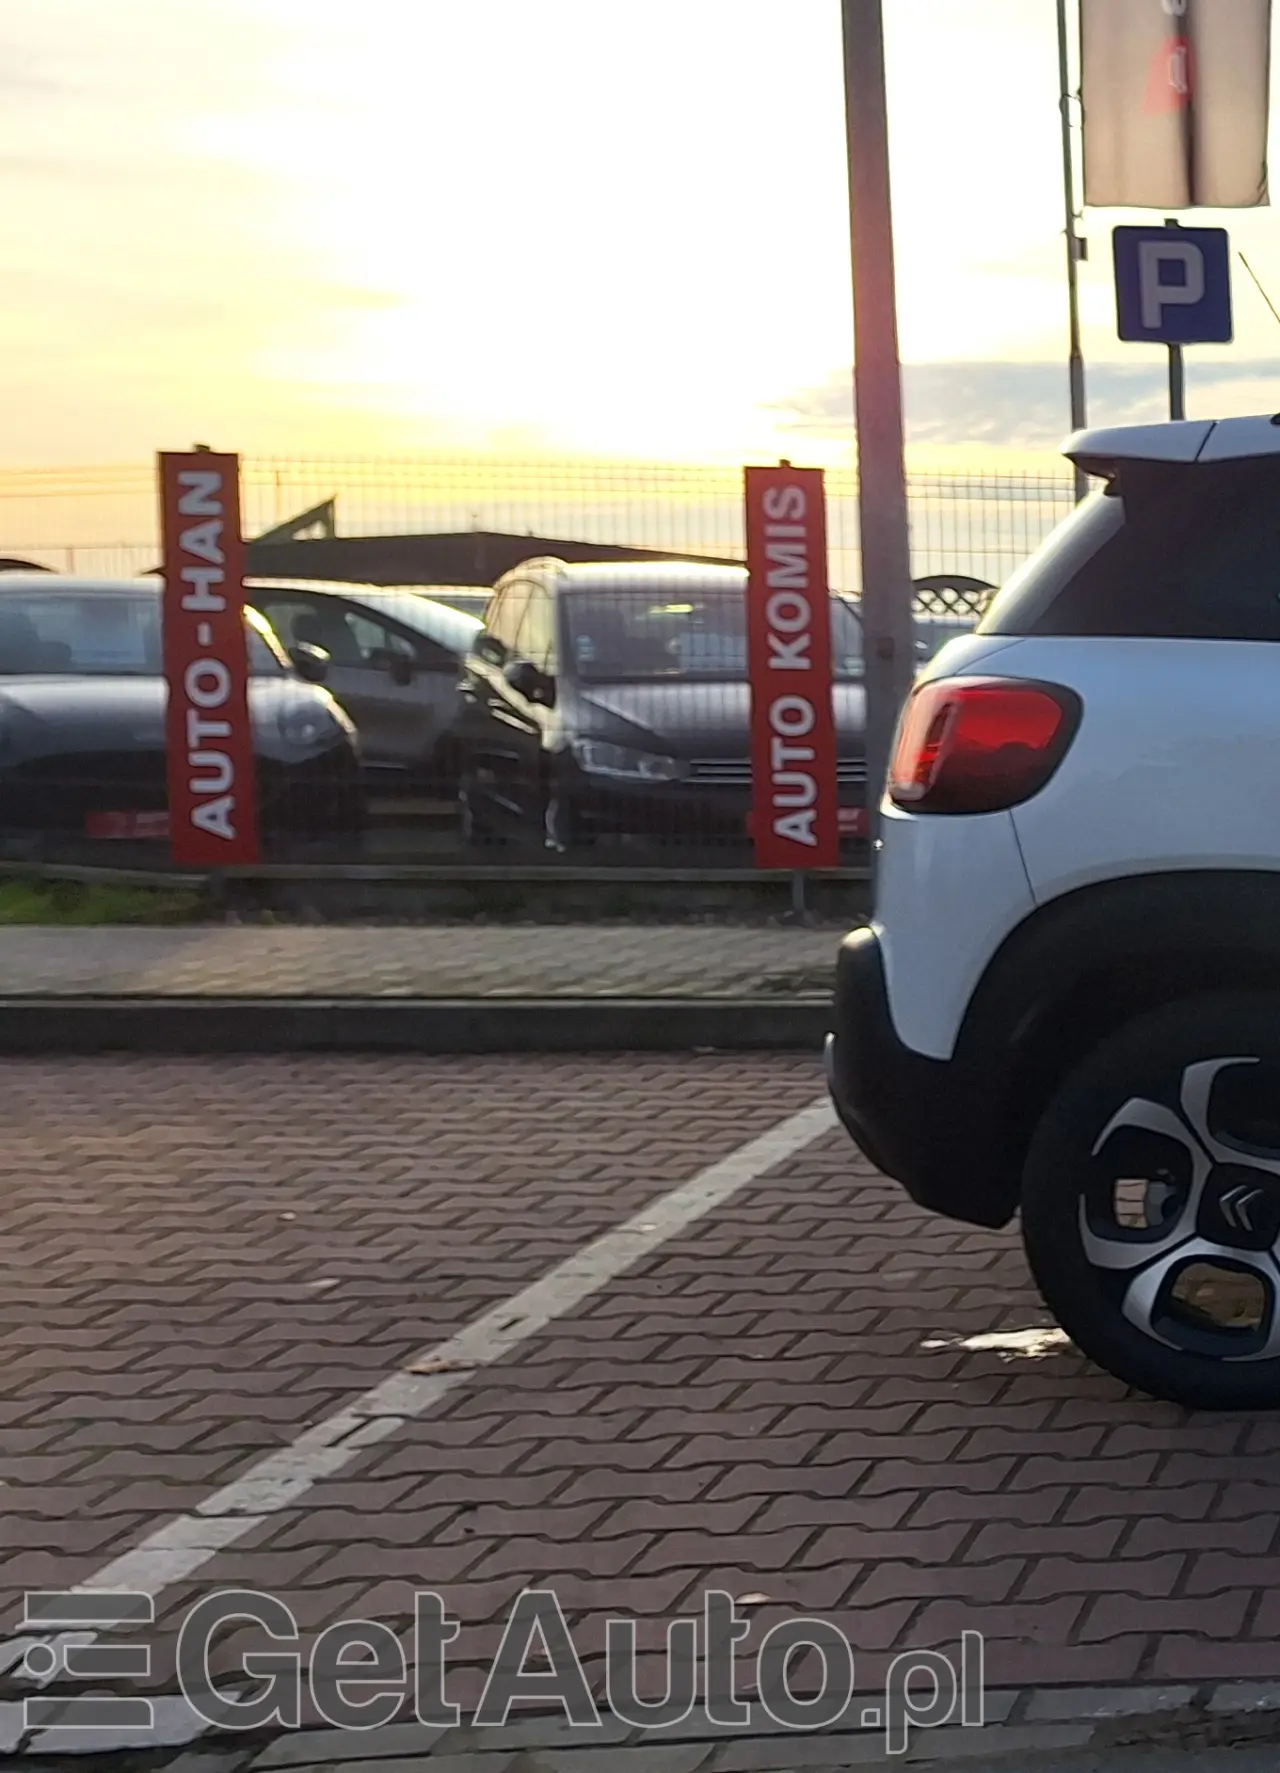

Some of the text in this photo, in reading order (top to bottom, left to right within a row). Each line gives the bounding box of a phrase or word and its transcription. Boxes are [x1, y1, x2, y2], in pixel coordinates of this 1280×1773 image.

[1138, 240, 1205, 329] P
[176, 469, 236, 841] AUTO-HAN
[762, 484, 818, 847] AUTO KOMIS
